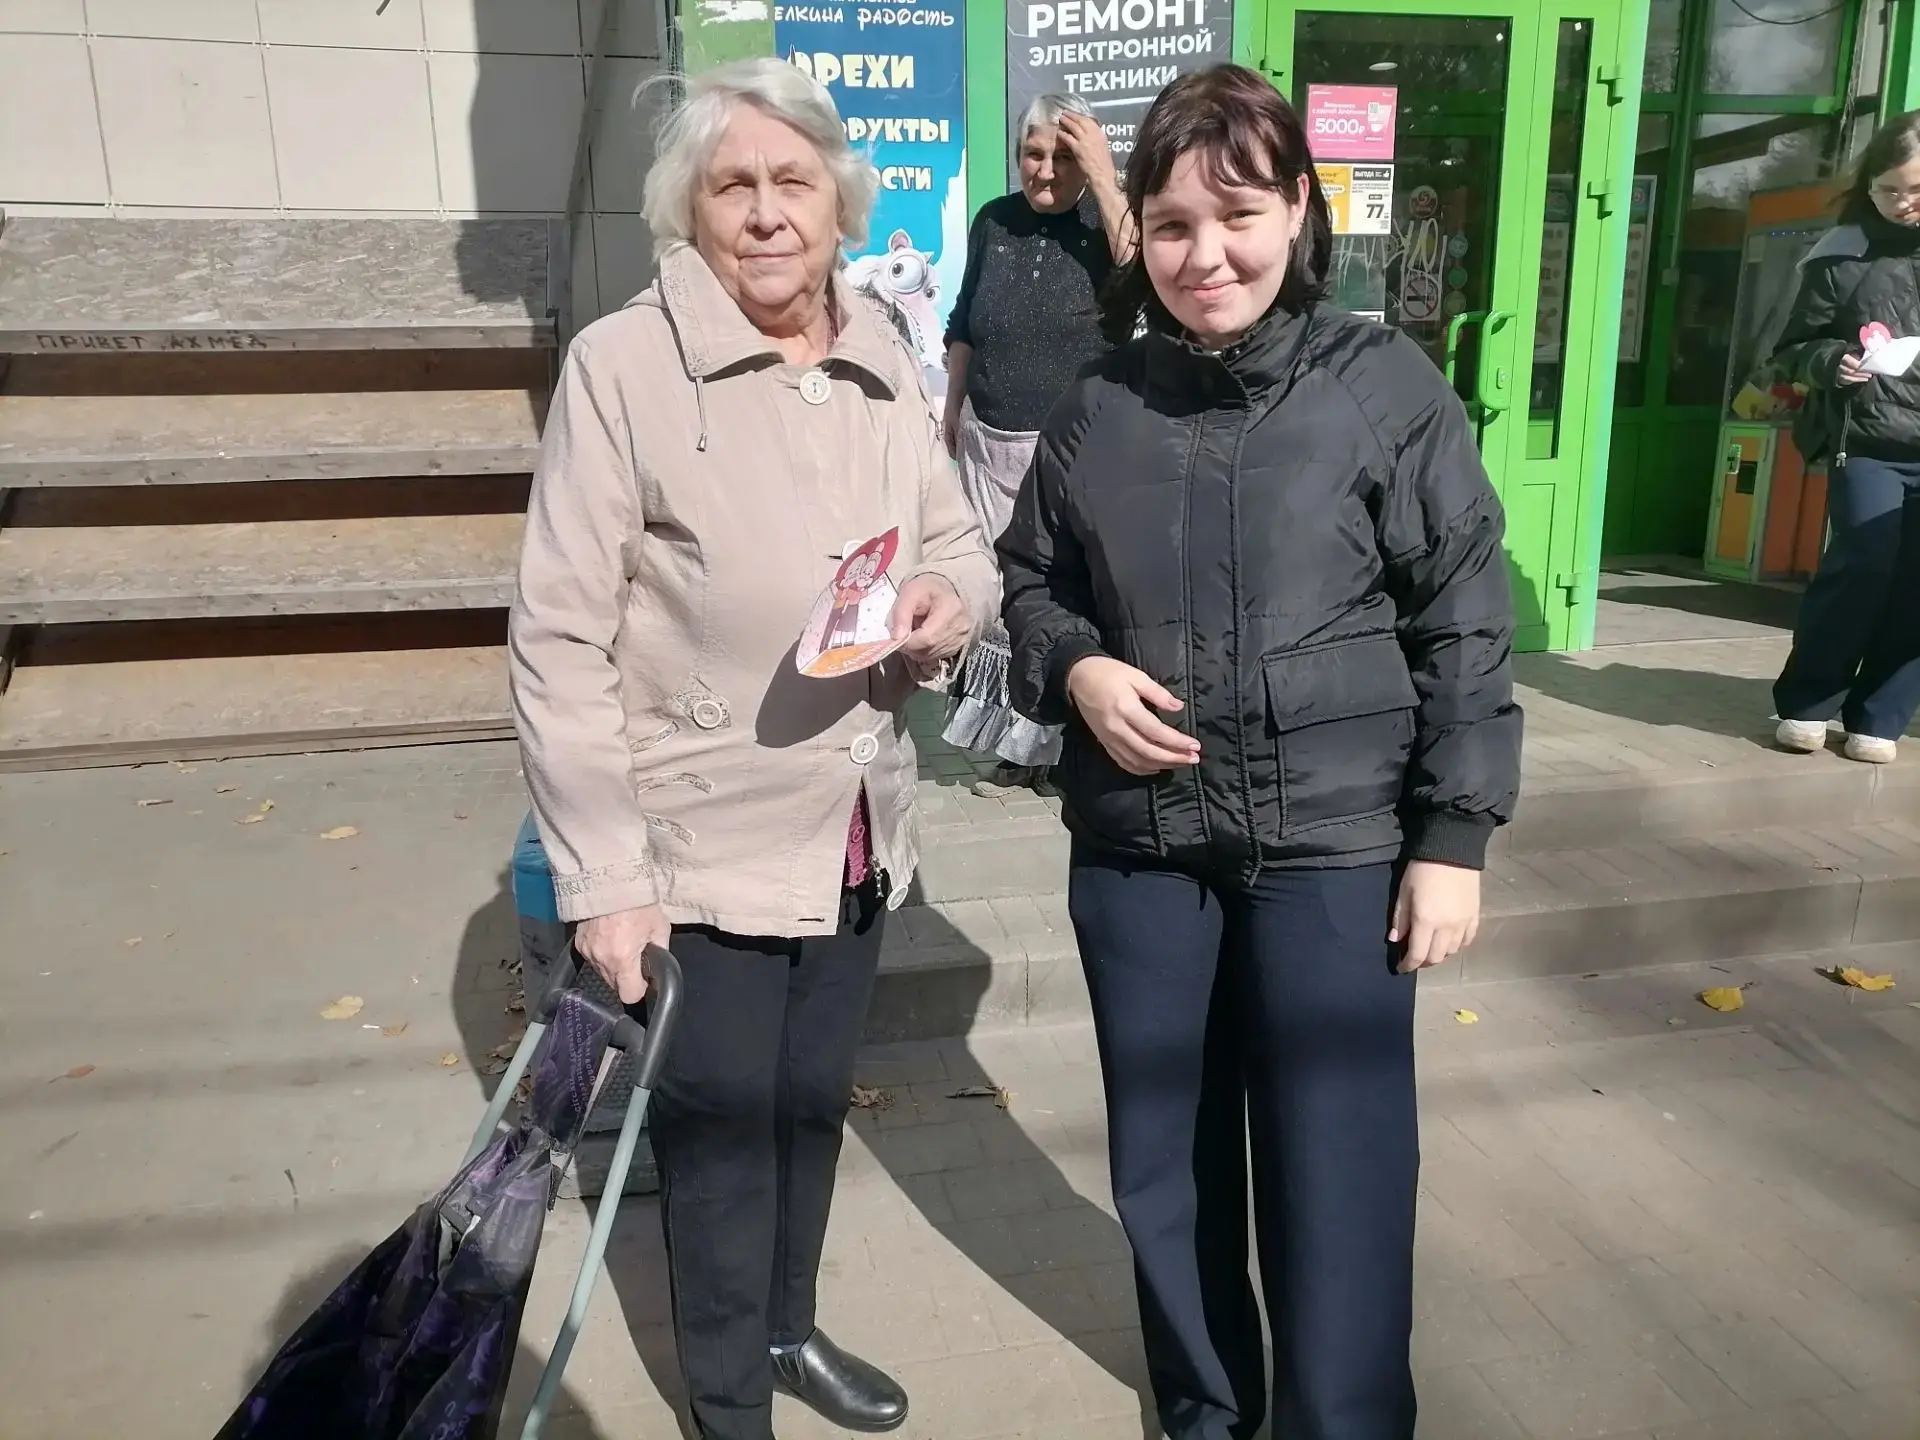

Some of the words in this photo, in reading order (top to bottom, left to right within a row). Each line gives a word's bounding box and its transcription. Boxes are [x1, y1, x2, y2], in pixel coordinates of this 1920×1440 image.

[1027, 0, 1206, 38] РЕМОНТ
[1028, 27, 1213, 67] ЭЛЕКТРОННОЙ
[1063, 65, 1178, 94] ТЕХНИКИ
